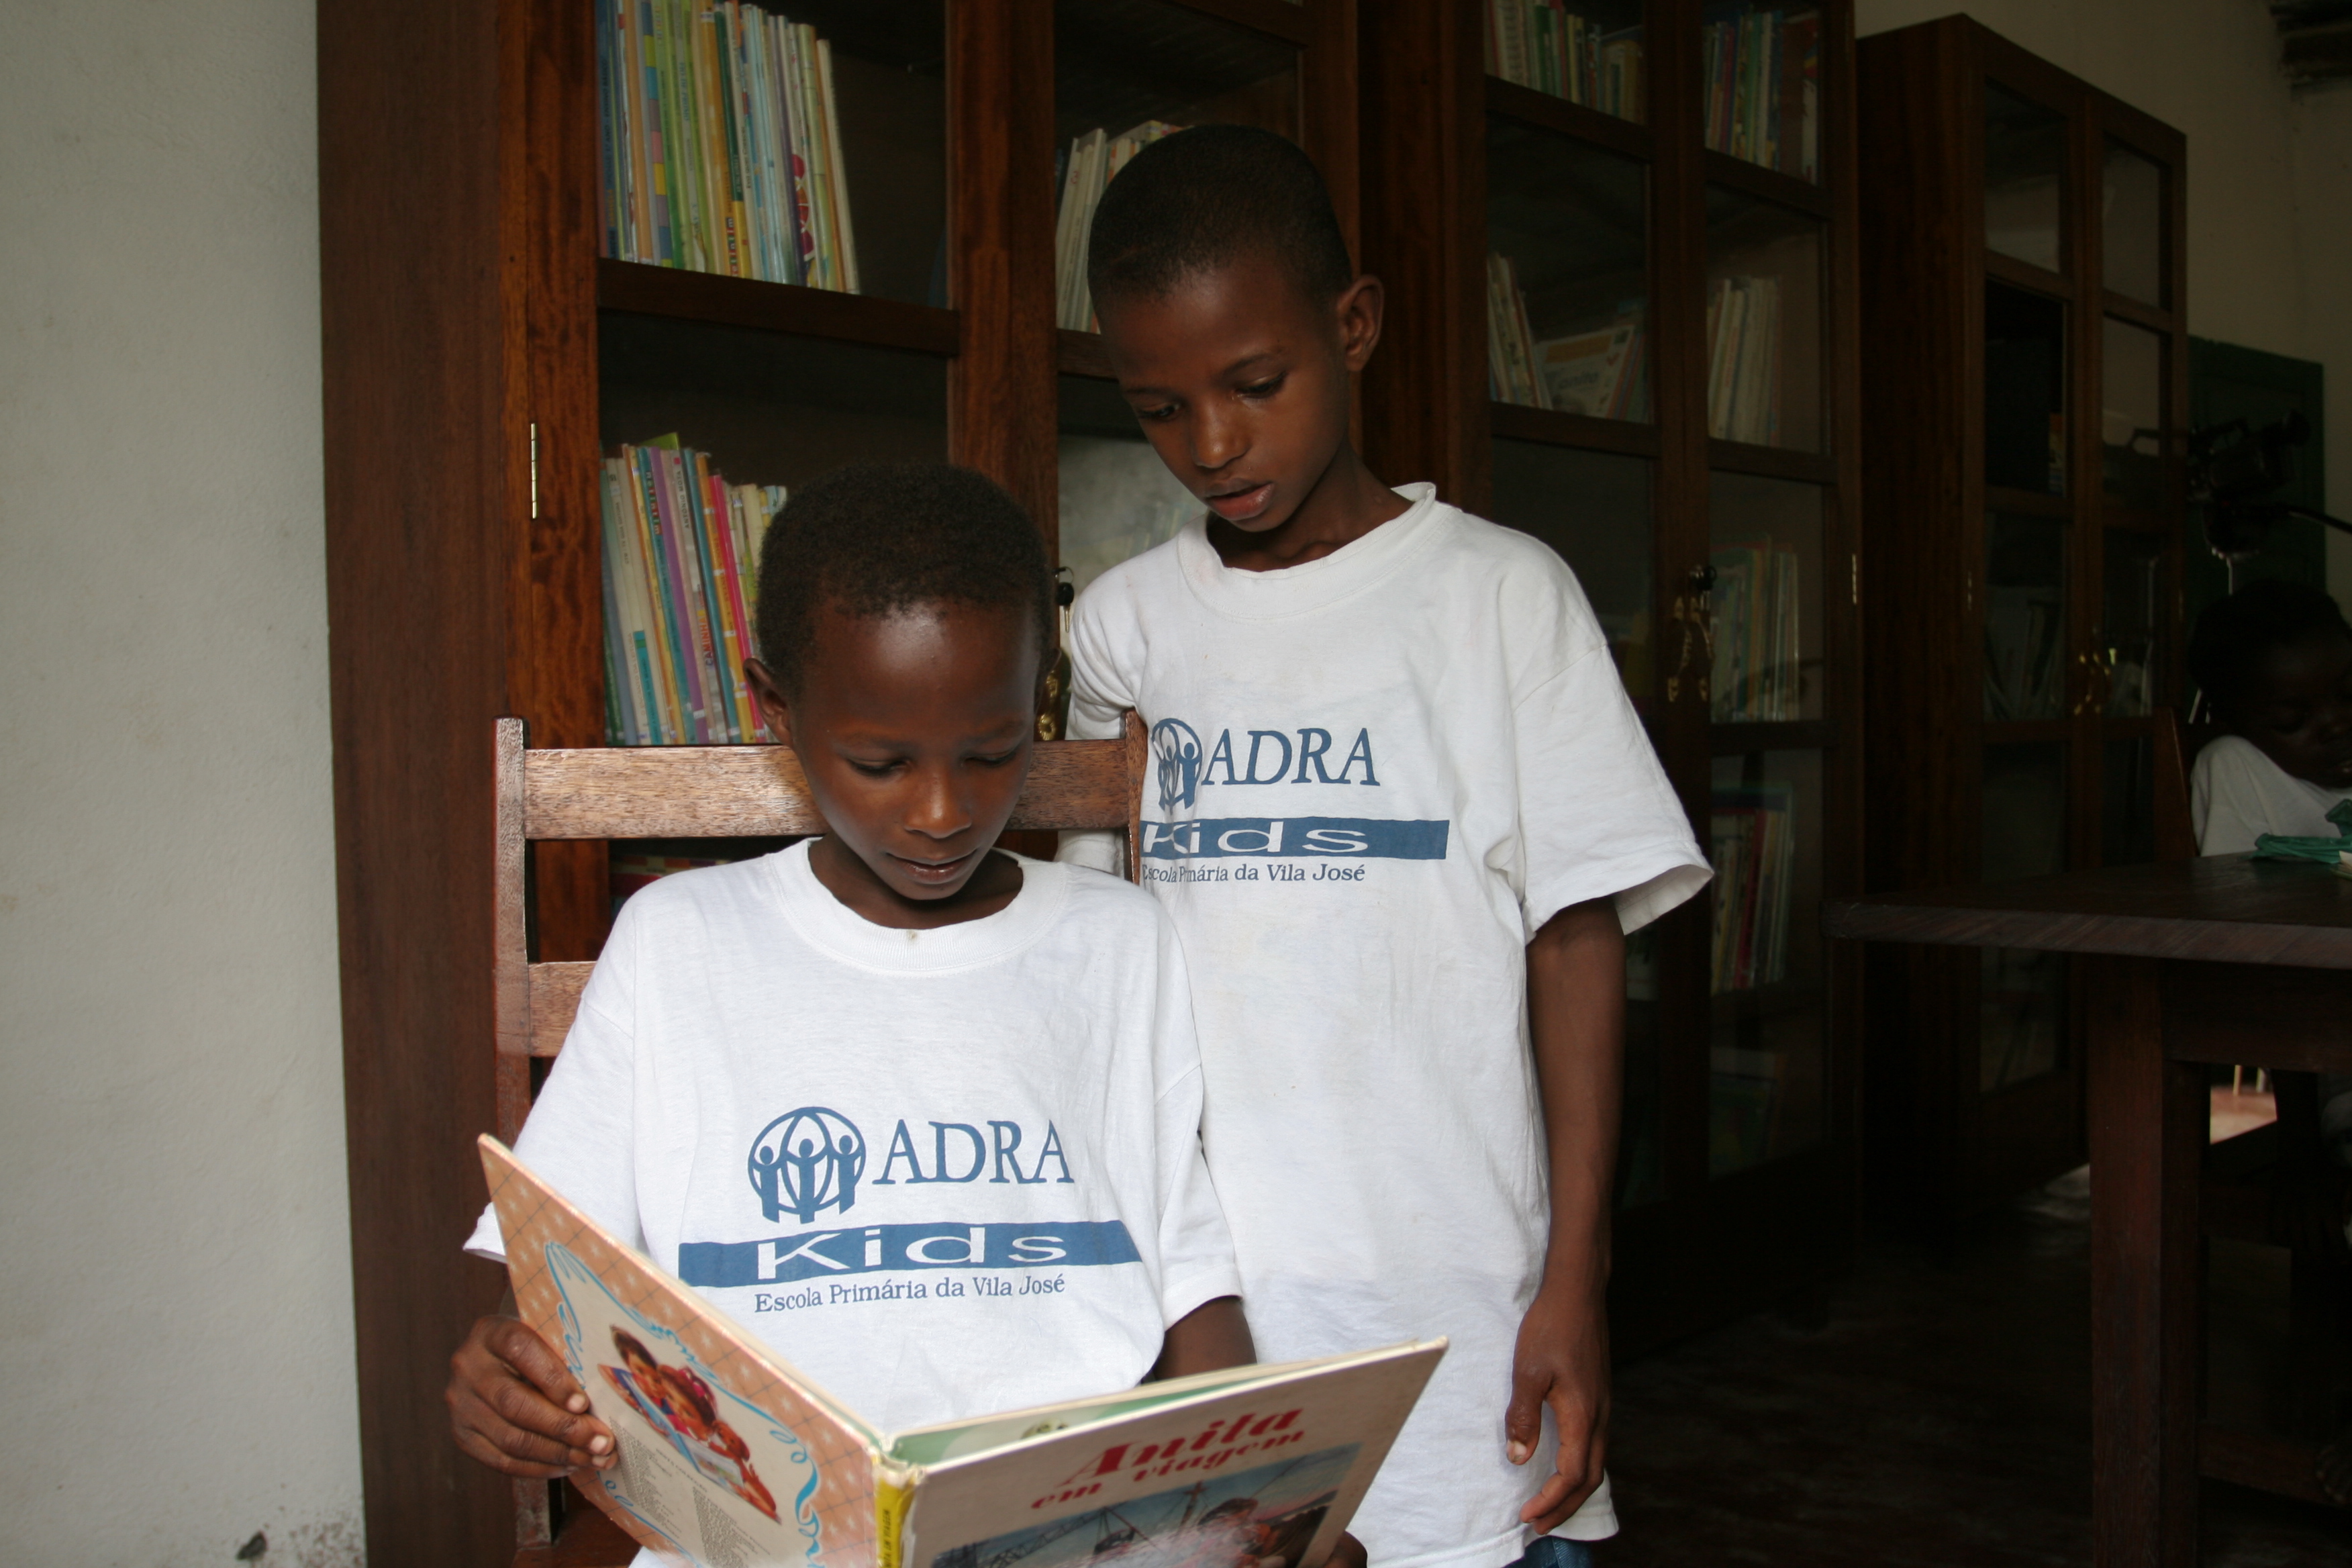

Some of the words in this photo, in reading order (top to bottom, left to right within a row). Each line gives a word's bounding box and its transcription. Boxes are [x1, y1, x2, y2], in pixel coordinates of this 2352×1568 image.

[679, 494, 689, 528] ANTÓNIO
[1201, 728, 1380, 786] ADRA
[1142, 821, 1369, 853] Kids
[1141, 864, 1177, 883] Escola
[1234, 865, 1259, 880] da
[1267, 864, 1305, 881] Vila
[1312, 863, 1366, 881] José
[872, 1119, 1075, 1184] ADRA
[757, 1227, 1067, 1279] Kids
[754, 1287, 823, 1313] Escola
[829, 1279, 928, 1304] Primária
[934, 1275, 965, 1297] da
[973, 1277, 1012, 1296] Vila
[1018, 1273, 1065, 1295] José
[1031, 1483, 1102, 1509] em
[1133, 1430, 1304, 1482] viagem
[1057, 1409, 1303, 1487] Anita
